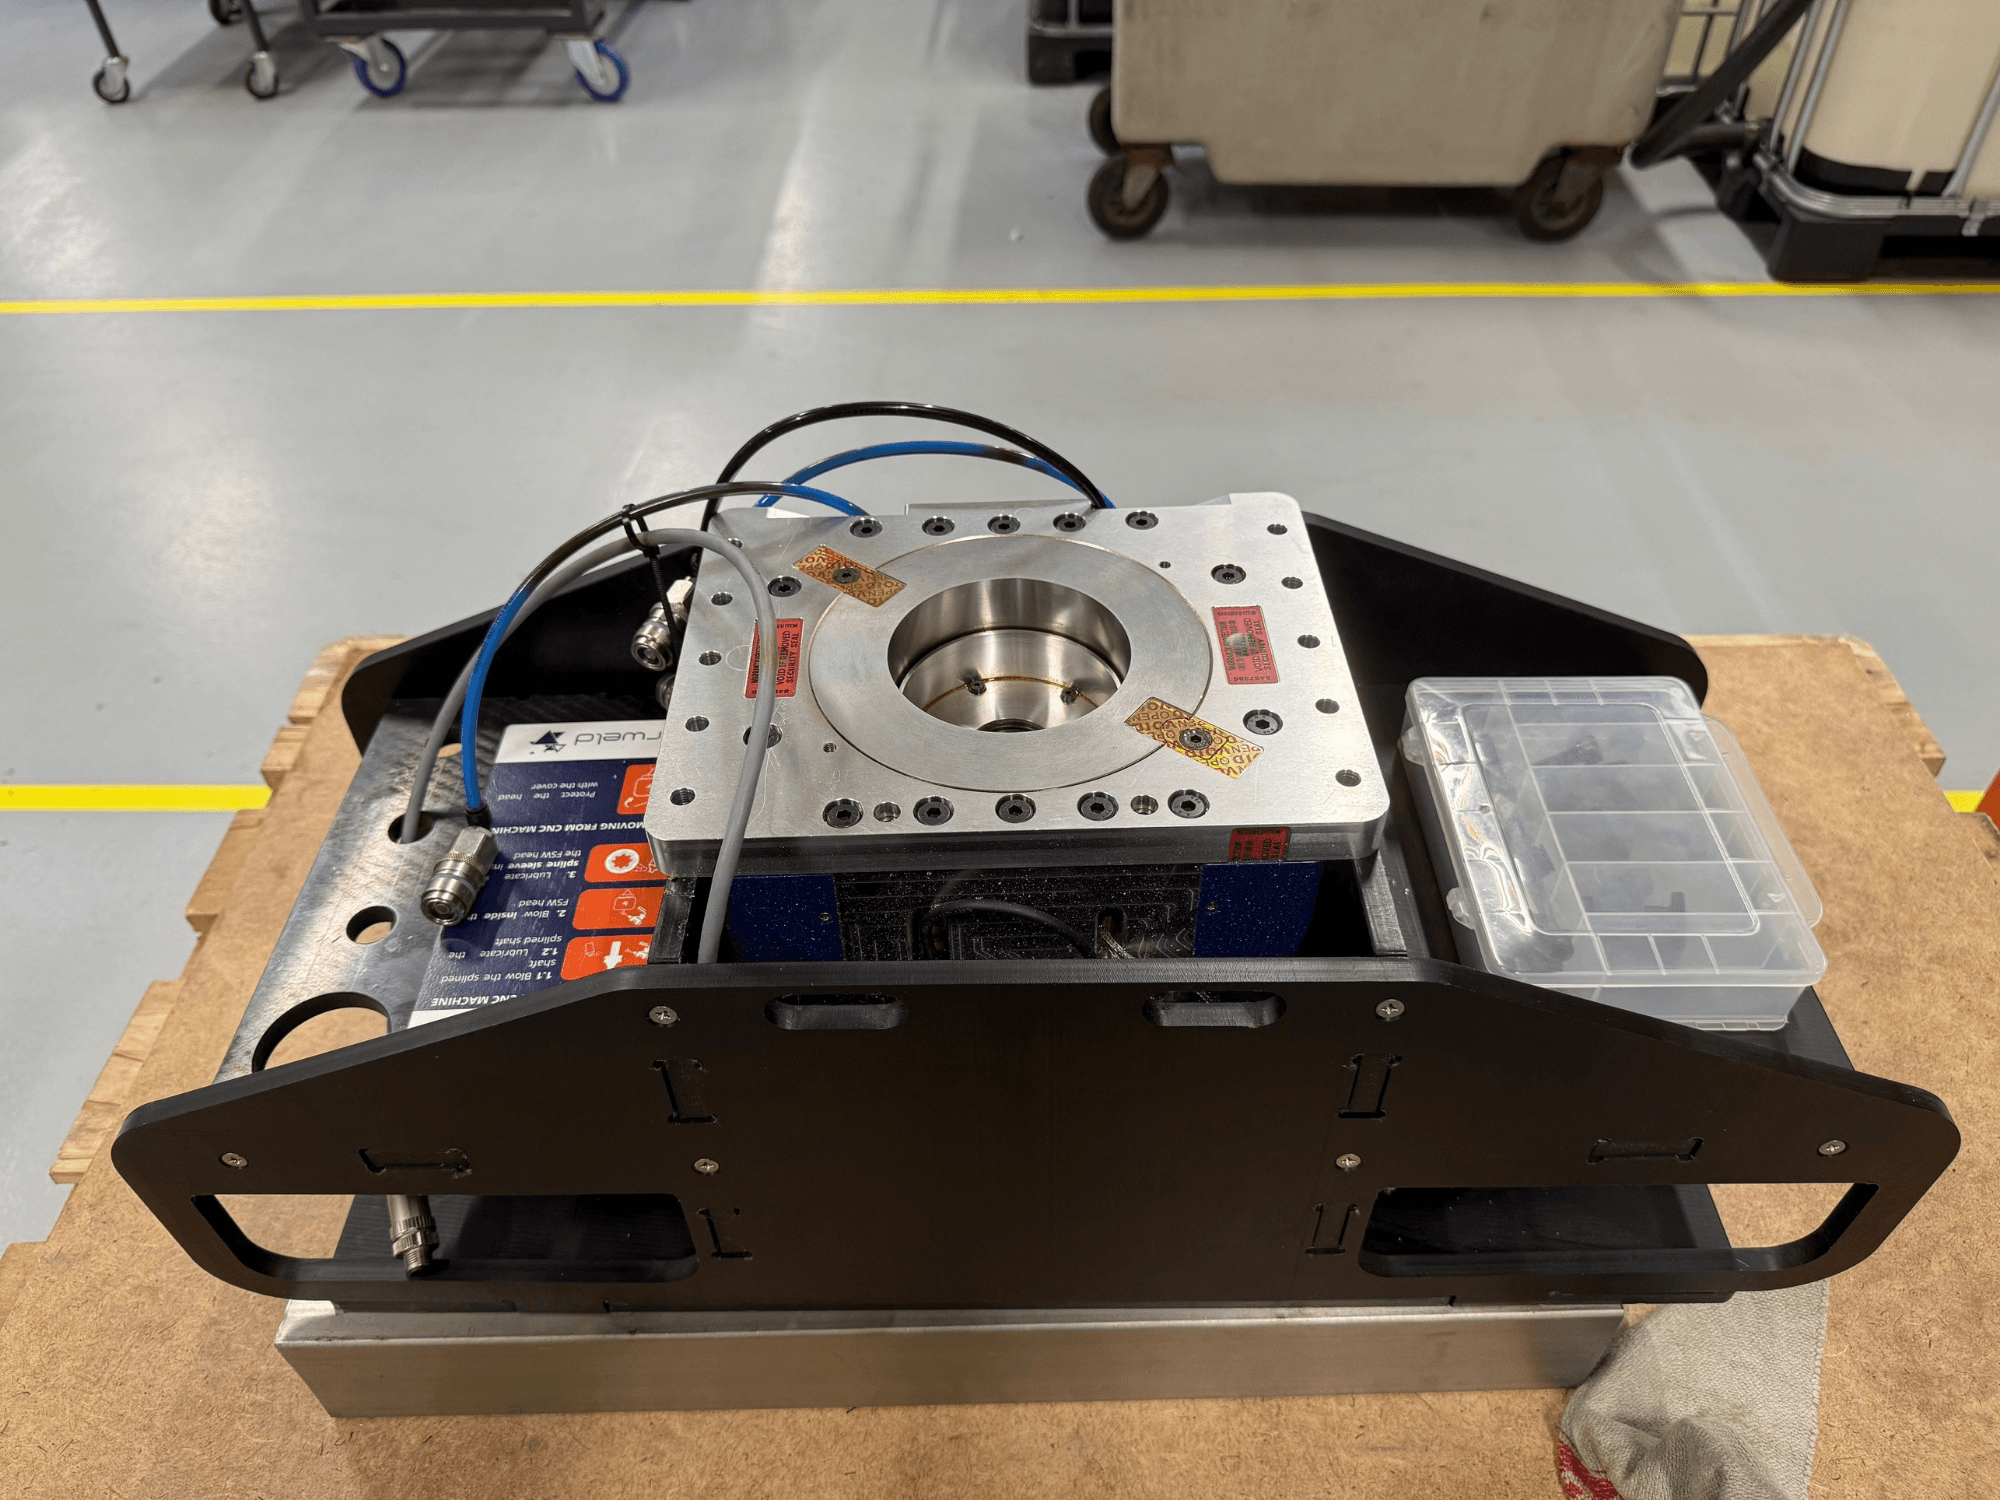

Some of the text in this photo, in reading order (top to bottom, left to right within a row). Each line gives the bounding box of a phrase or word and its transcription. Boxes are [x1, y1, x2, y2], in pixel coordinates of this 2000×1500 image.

[1244, 618, 1257, 648] REMOVED
[779, 630, 790, 660] REMOVED
[1253, 620, 1271, 671] SECURITY SEAL
[786, 632, 800, 684] SECURITY SEAL
[1252, 656, 1263, 672] VOID
[776, 668, 786, 686] VOID
[574, 731, 662, 746] rweld
[530, 781, 599, 791] with the cover
[498, 791, 596, 801] Protect the head
[491, 821, 645, 835] MOVING FROM CNC MACHIN
[513, 849, 582, 860] the FSW head
[508, 862, 543, 871] sleeve
[547, 858, 580, 869] spline
[504, 870, 577, 880] 3. Lubricate
[518, 898, 569, 908] FSW head
[484, 911, 518, 920] inside
[523, 910, 550, 919] Blow
[556, 909, 567, 918] 2.
[494, 934, 563, 947] splined shaft
[449, 947, 559, 960] 1.2 Lubricate the
[528, 959, 557, 969] shaft
[440, 971, 552, 984] 1.1 Blow the splined
[431, 996, 490, 1007] MACHINE
